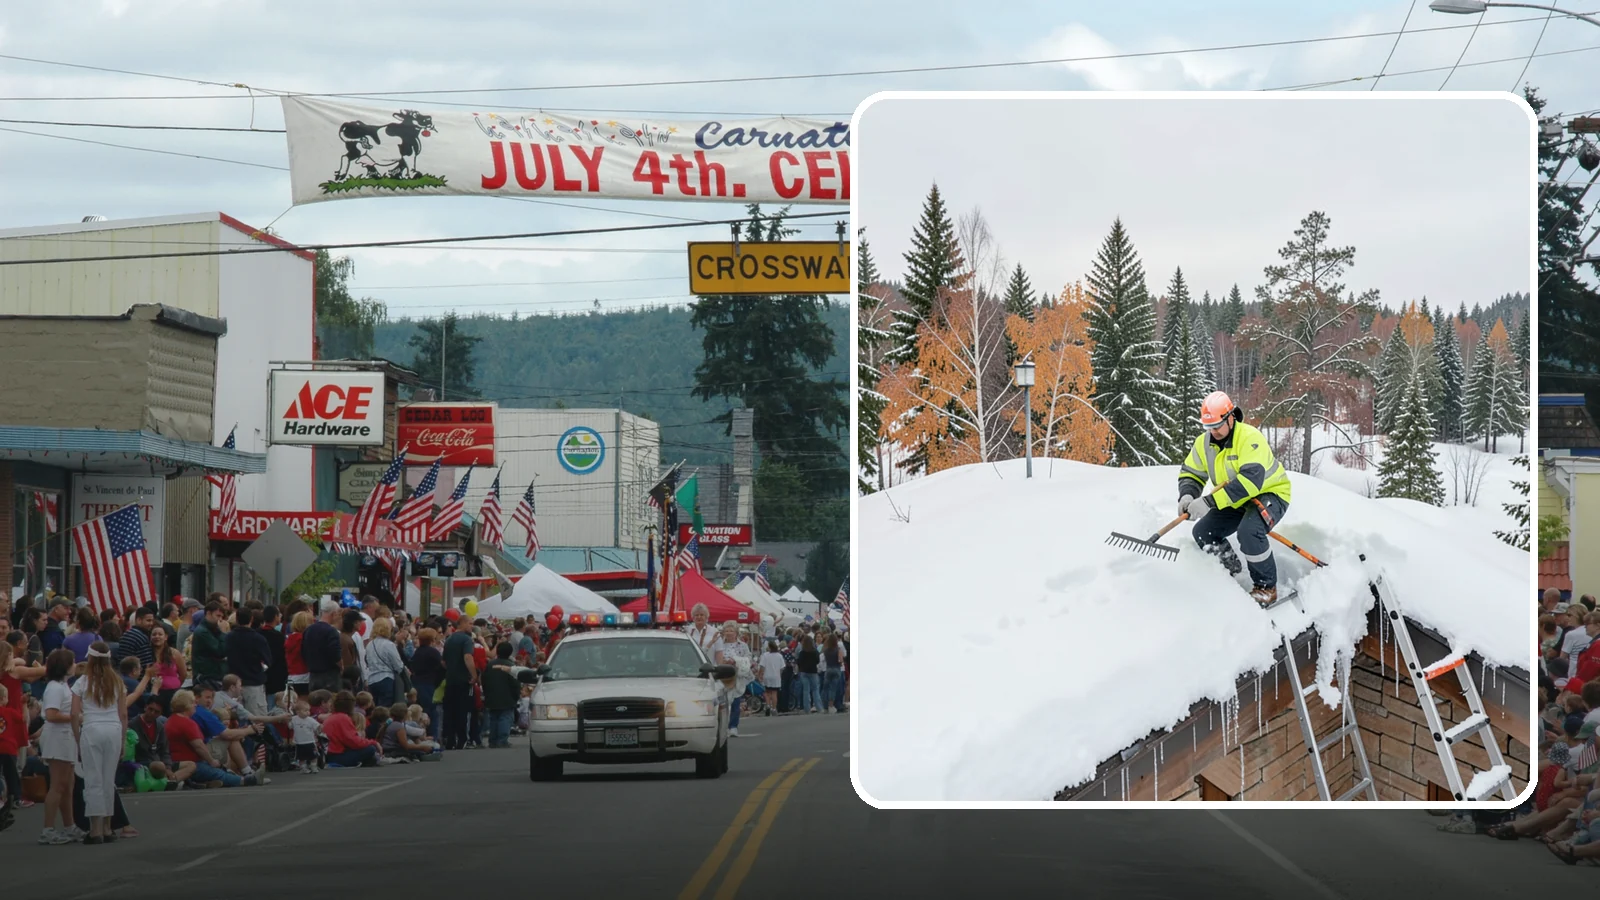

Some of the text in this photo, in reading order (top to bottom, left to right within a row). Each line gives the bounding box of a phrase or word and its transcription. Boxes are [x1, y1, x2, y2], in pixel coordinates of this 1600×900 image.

[481, 140, 604, 192] JULY
[632, 150, 746, 198] 4th.
[697, 254, 850, 280] CROSSWA
[283, 380, 374, 420] ACE
[406, 409, 452, 421] CEDAR
[283, 421, 371, 437] Hardware
[416, 428, 477, 447] Coca-Cola
[95, 485, 124, 494] Vincent
[126, 486, 136, 495] de
[138, 486, 155, 495] Paul
[212, 516, 330, 535] HARDARE
[688, 526, 742, 535] CRNATION
[699, 535, 730, 543] GLASS
